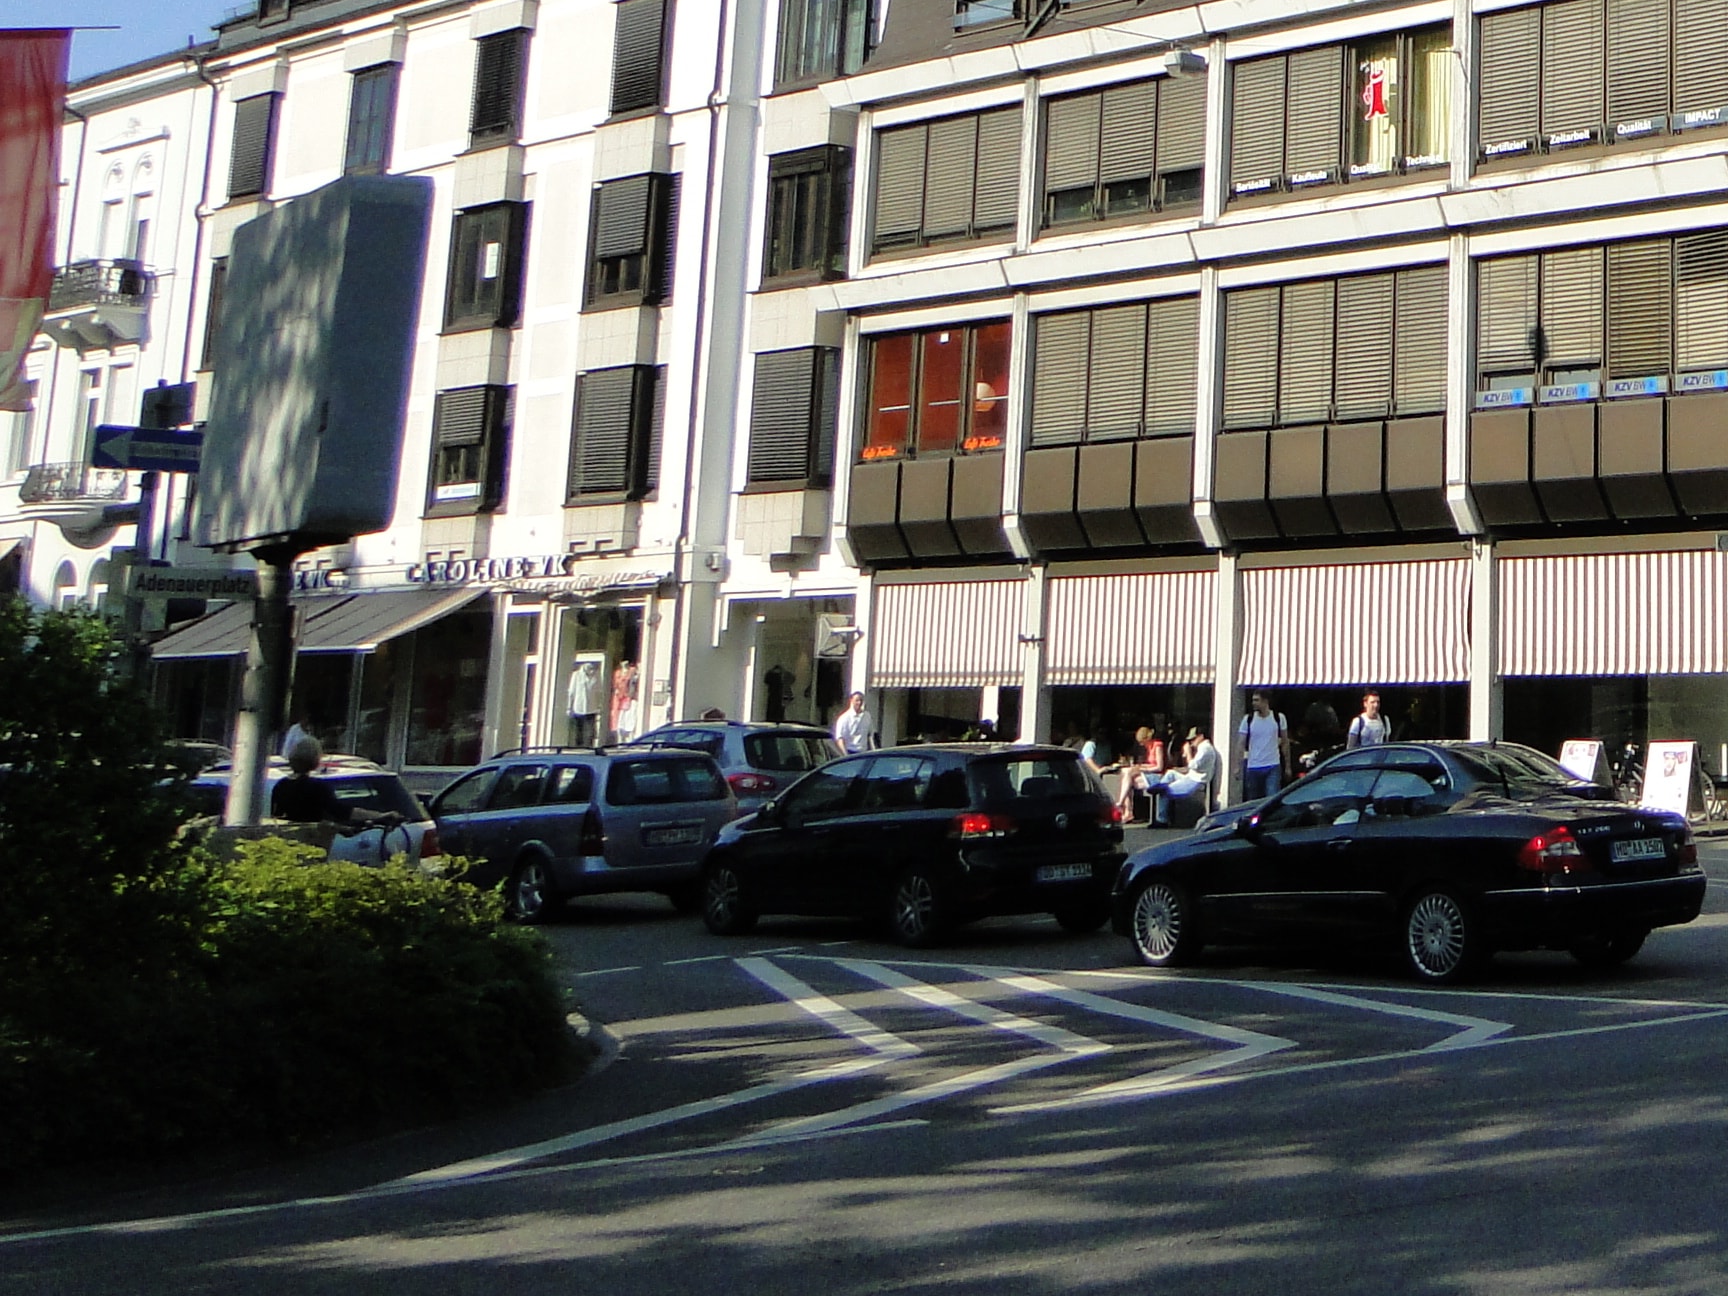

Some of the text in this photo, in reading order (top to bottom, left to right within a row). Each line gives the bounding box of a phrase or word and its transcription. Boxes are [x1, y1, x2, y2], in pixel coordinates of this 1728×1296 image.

[1684, 108, 1721, 124] IMPACT
[1683, 376, 1702, 386] KZV
[1614, 382, 1633, 392] KZV
[1548, 388, 1566, 398] KZV
[1483, 394, 1501, 403] KZV
[405, 556, 524, 584] CAROLINE
[135, 573, 250, 597] Adenauerplatz
